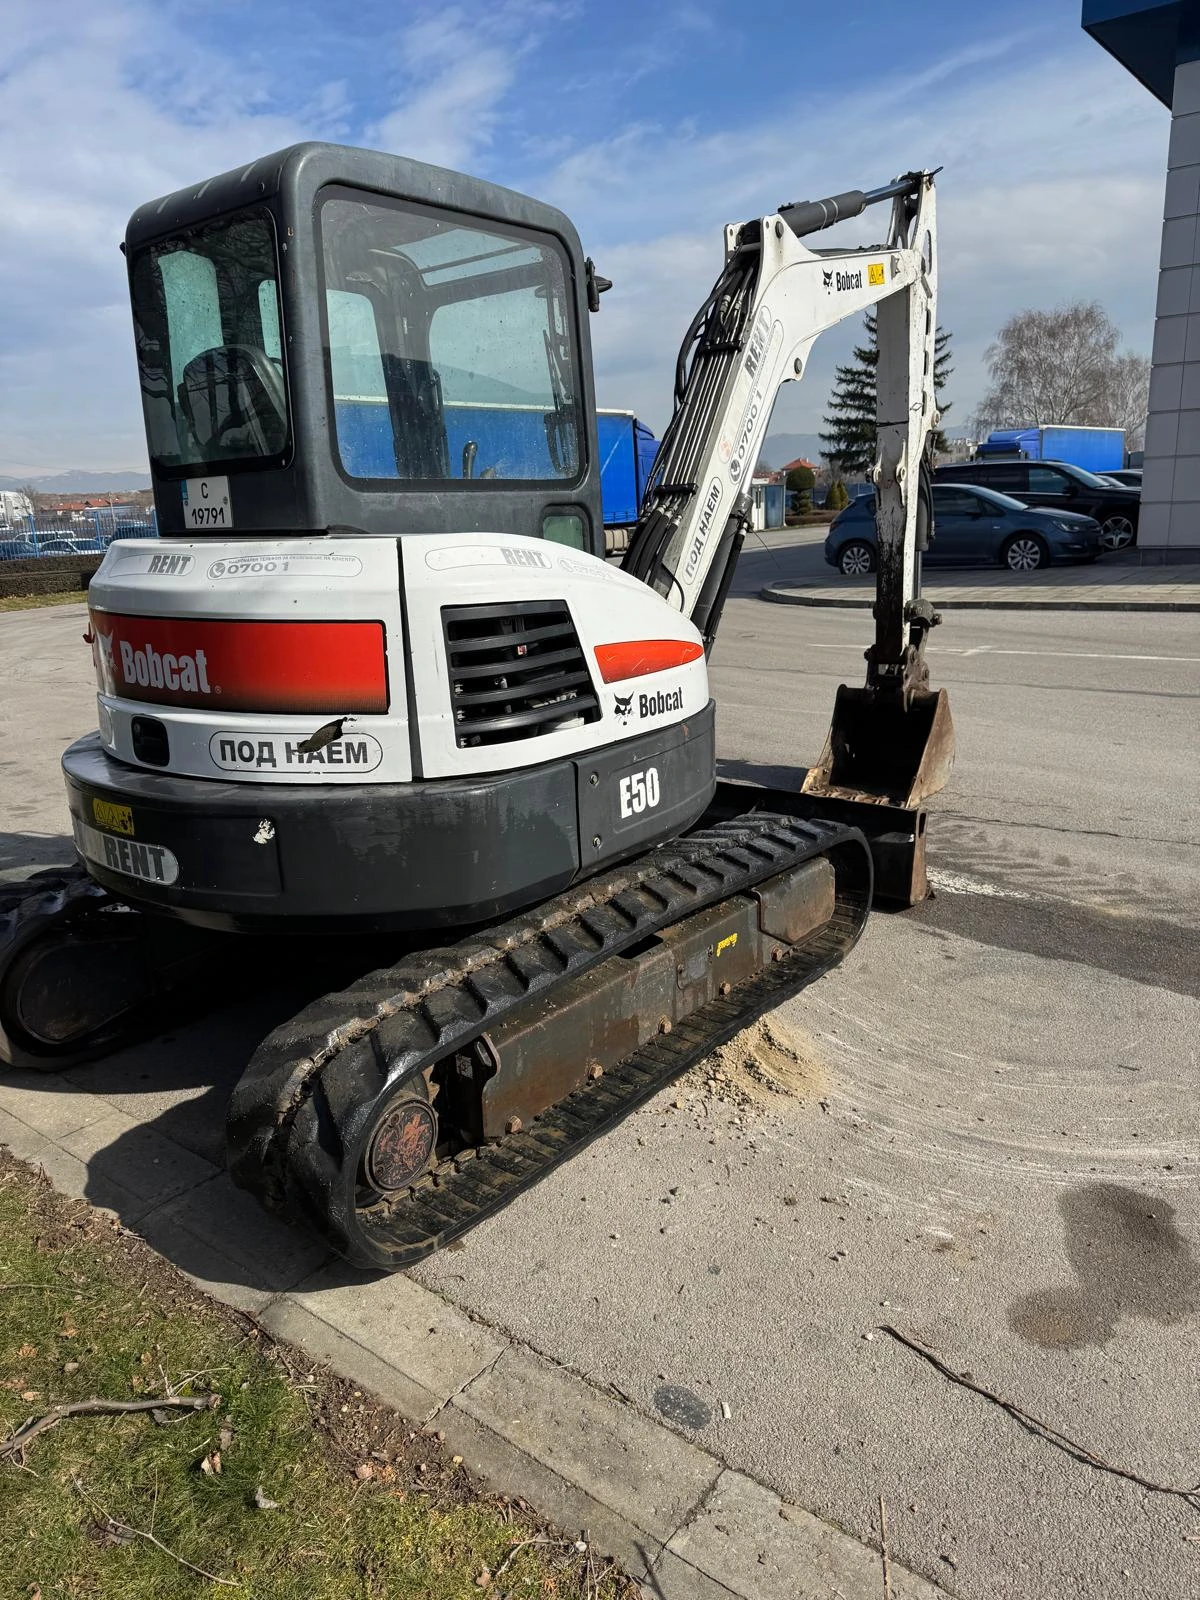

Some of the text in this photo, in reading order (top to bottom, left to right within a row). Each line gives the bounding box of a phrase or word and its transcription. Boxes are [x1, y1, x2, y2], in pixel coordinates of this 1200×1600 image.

[836, 269, 862, 292] Bobcat
[744, 309, 769, 379] RENT
[738, 404, 758, 459] 0700
[191, 507, 225, 525] 19791
[685, 484, 721, 578] ПОД НАЕМ
[147, 555, 192, 575] RENT
[227, 562, 277, 574] 0700
[501, 549, 546, 567] RENT
[119, 640, 211, 694] Bobcat
[639, 686, 683, 718] Bobcat
[219, 739, 277, 768] ПОД
[619, 767, 660, 819] E50
[103, 834, 165, 882] RENT
